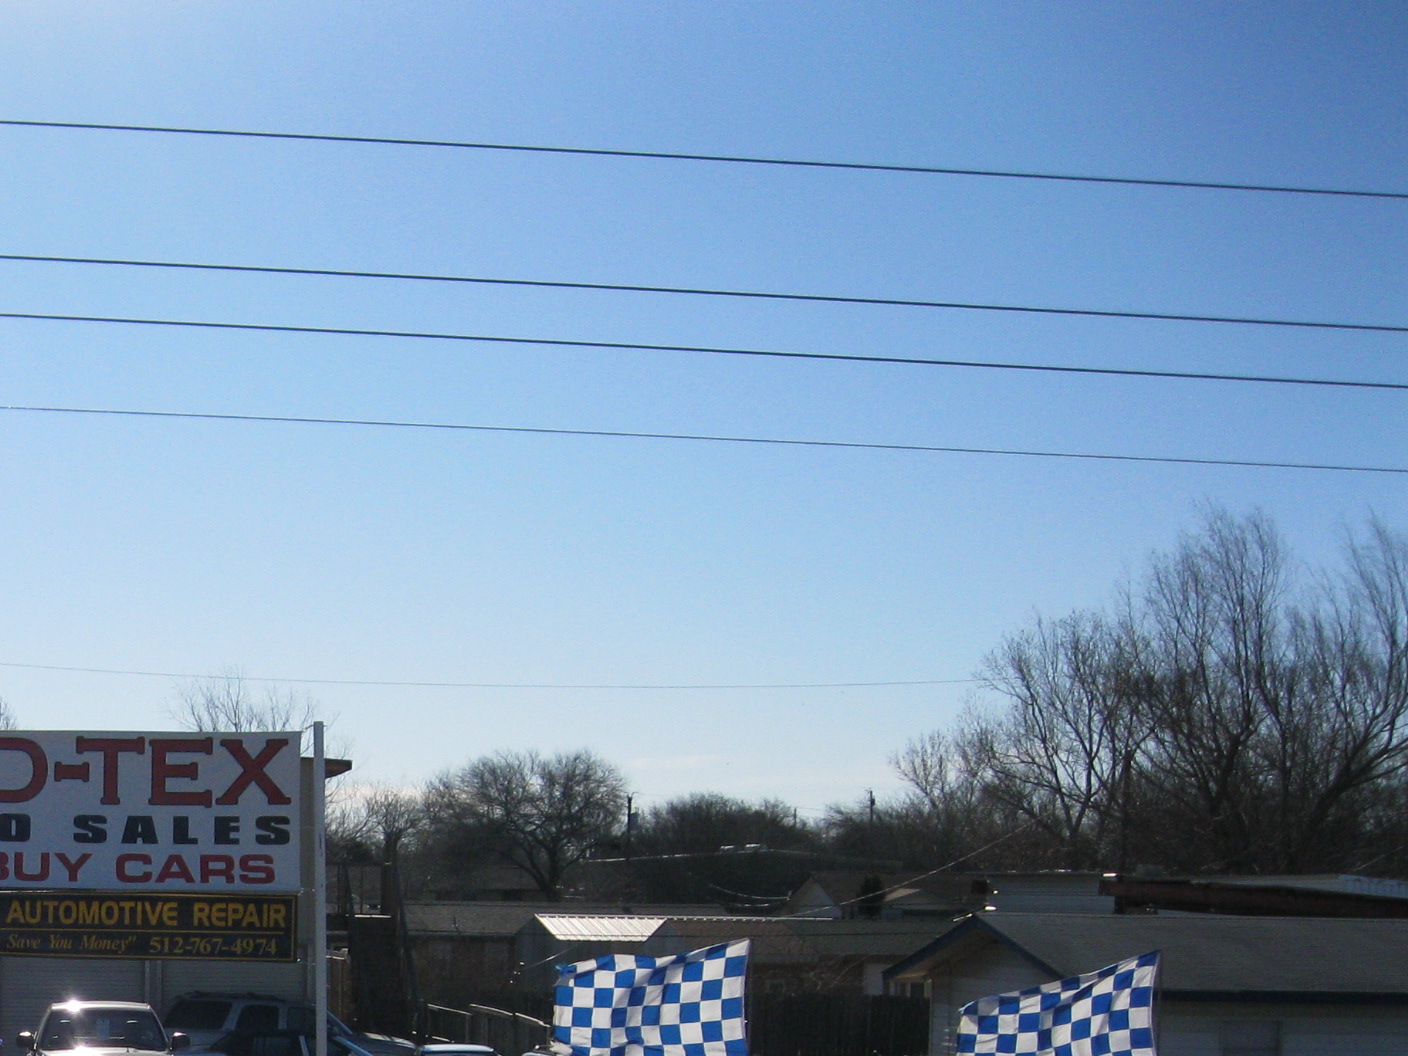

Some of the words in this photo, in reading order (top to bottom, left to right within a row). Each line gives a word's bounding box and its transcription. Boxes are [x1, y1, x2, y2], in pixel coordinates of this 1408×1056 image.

[73, 814, 291, 846] SALES
[115, 853, 276, 884] CARS
[5, 900, 179, 926] AUTOMOTIVE
[193, 902, 286, 928] REPAIR
[6, 934, 41, 949] Save
[49, 934, 72, 949] You
[149, 936, 277, 956] 512-767-4974
